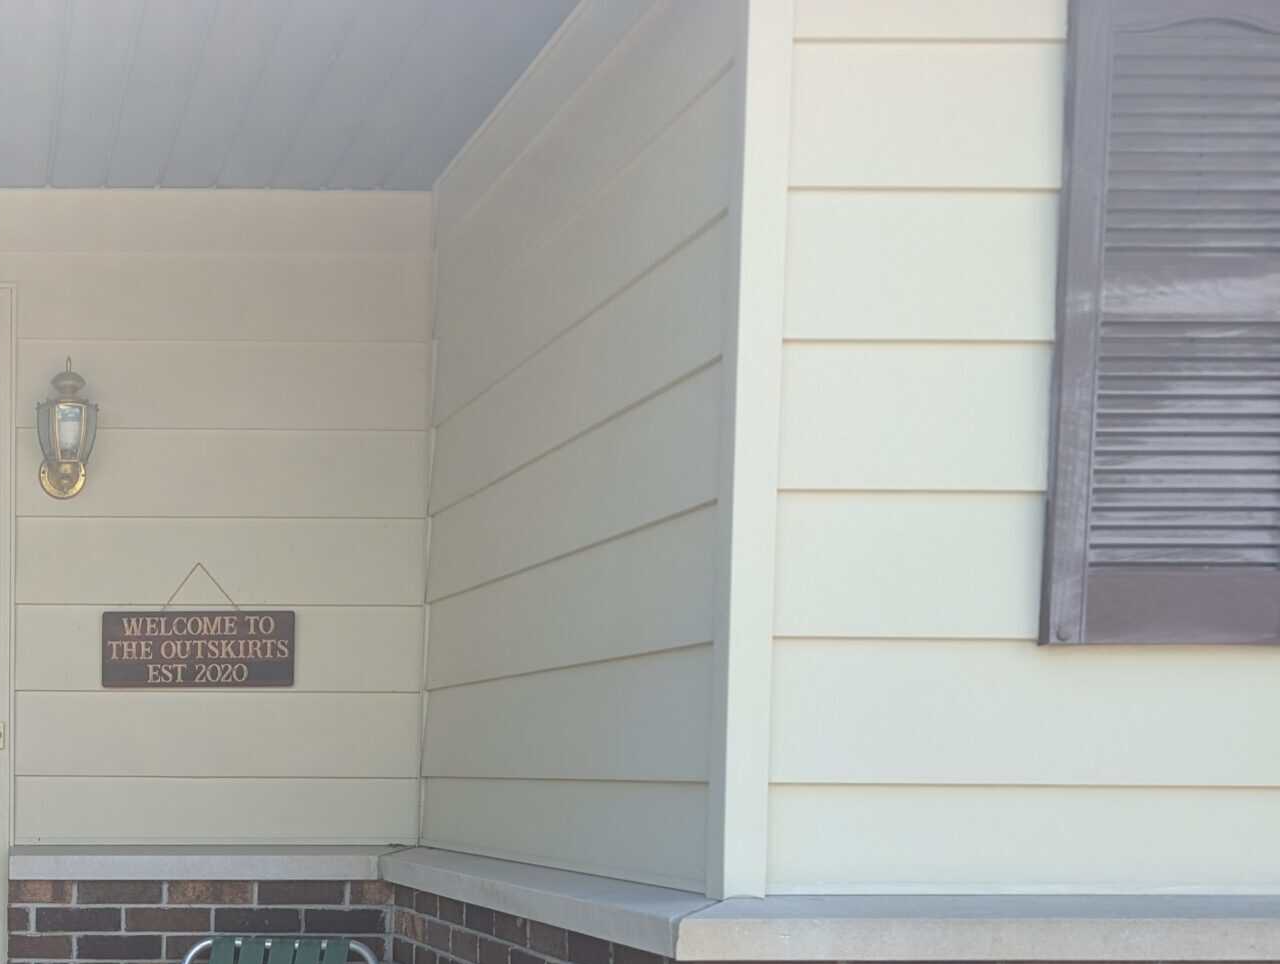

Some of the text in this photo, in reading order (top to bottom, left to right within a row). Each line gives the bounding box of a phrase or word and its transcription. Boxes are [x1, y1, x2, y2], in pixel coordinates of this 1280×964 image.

[122, 616, 275, 636] WELCOME TO
[108, 640, 289, 660] THE OUTSKIRTS
[147, 663, 248, 683] EST 2020
